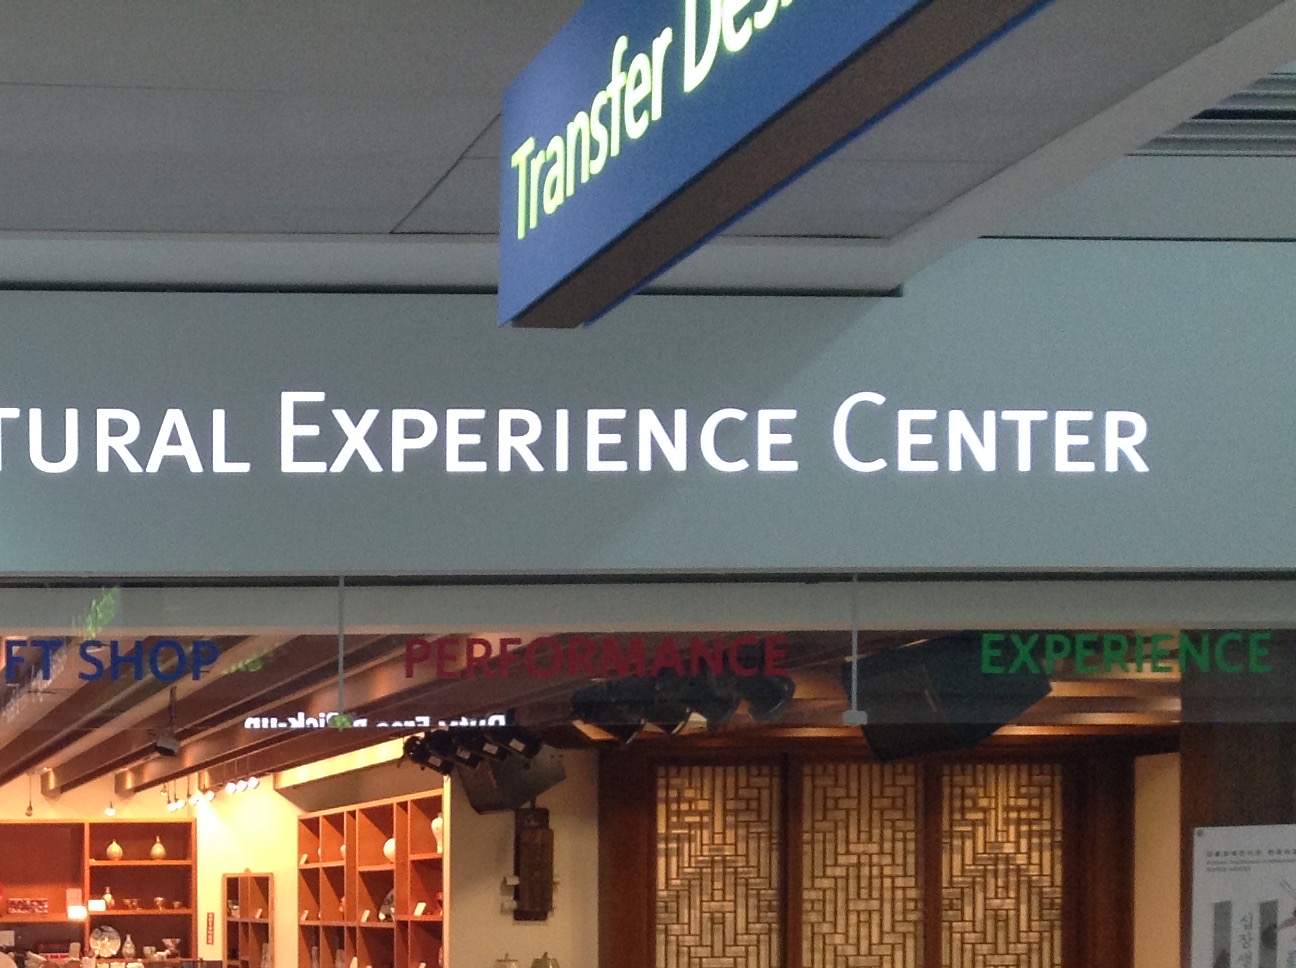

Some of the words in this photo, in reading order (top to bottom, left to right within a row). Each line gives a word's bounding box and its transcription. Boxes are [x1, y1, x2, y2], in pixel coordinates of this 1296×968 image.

[511, 27, 672, 240] Transfer
[281, 392, 798, 473] EXPERIENCE
[834, 391, 1149, 473] CENTER
[79, 638, 221, 682] SHOP
[404, 635, 790, 680] PERFORMANCE
[979, 632, 1273, 676] EXPERIENCE
